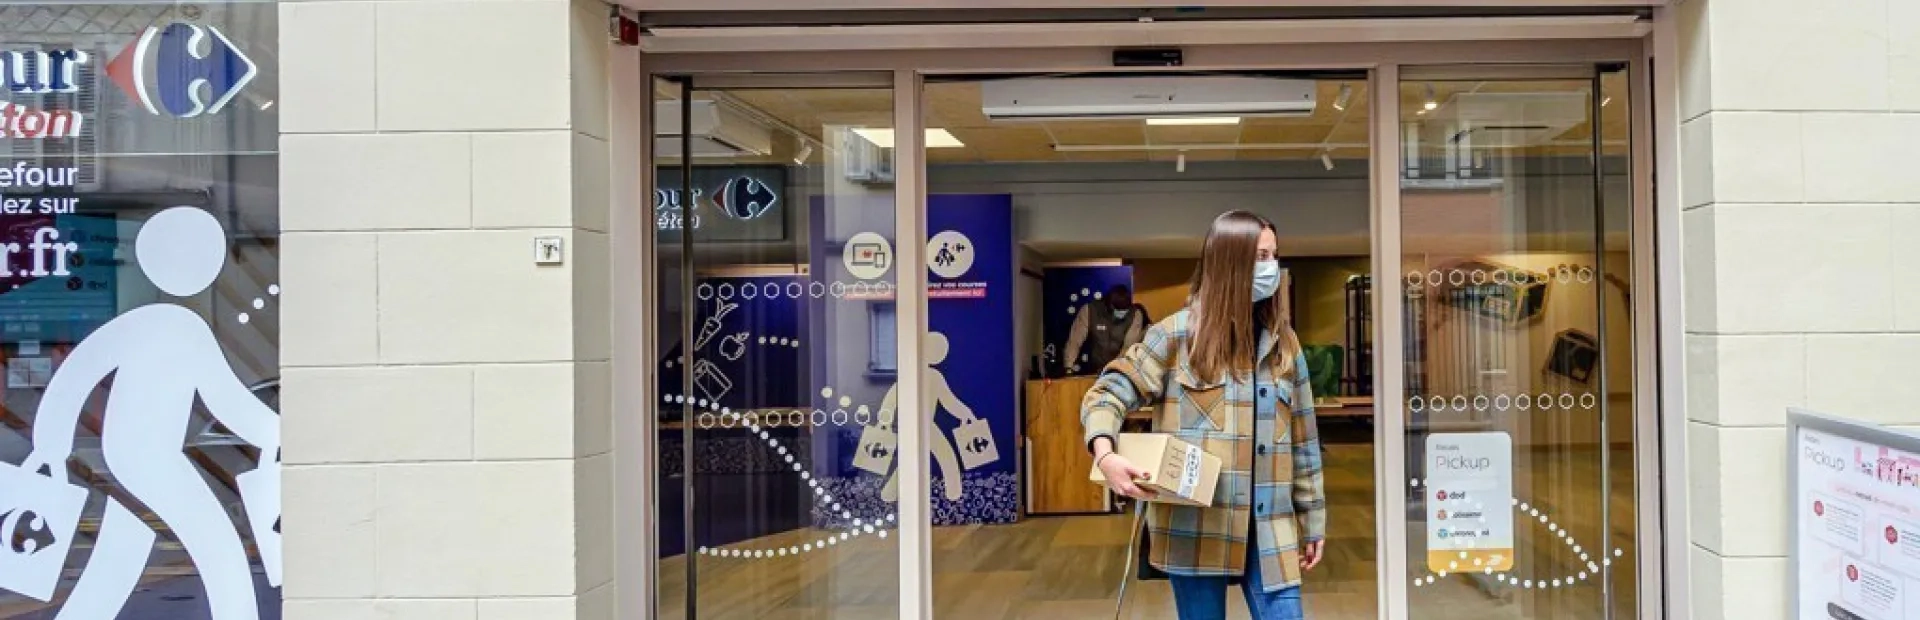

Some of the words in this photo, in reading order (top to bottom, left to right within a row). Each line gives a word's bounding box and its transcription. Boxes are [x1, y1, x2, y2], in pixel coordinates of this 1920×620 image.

[0, 50, 87, 93] ur
[39, 198, 79, 214] sur
[1436, 456, 1489, 470] Pickup
